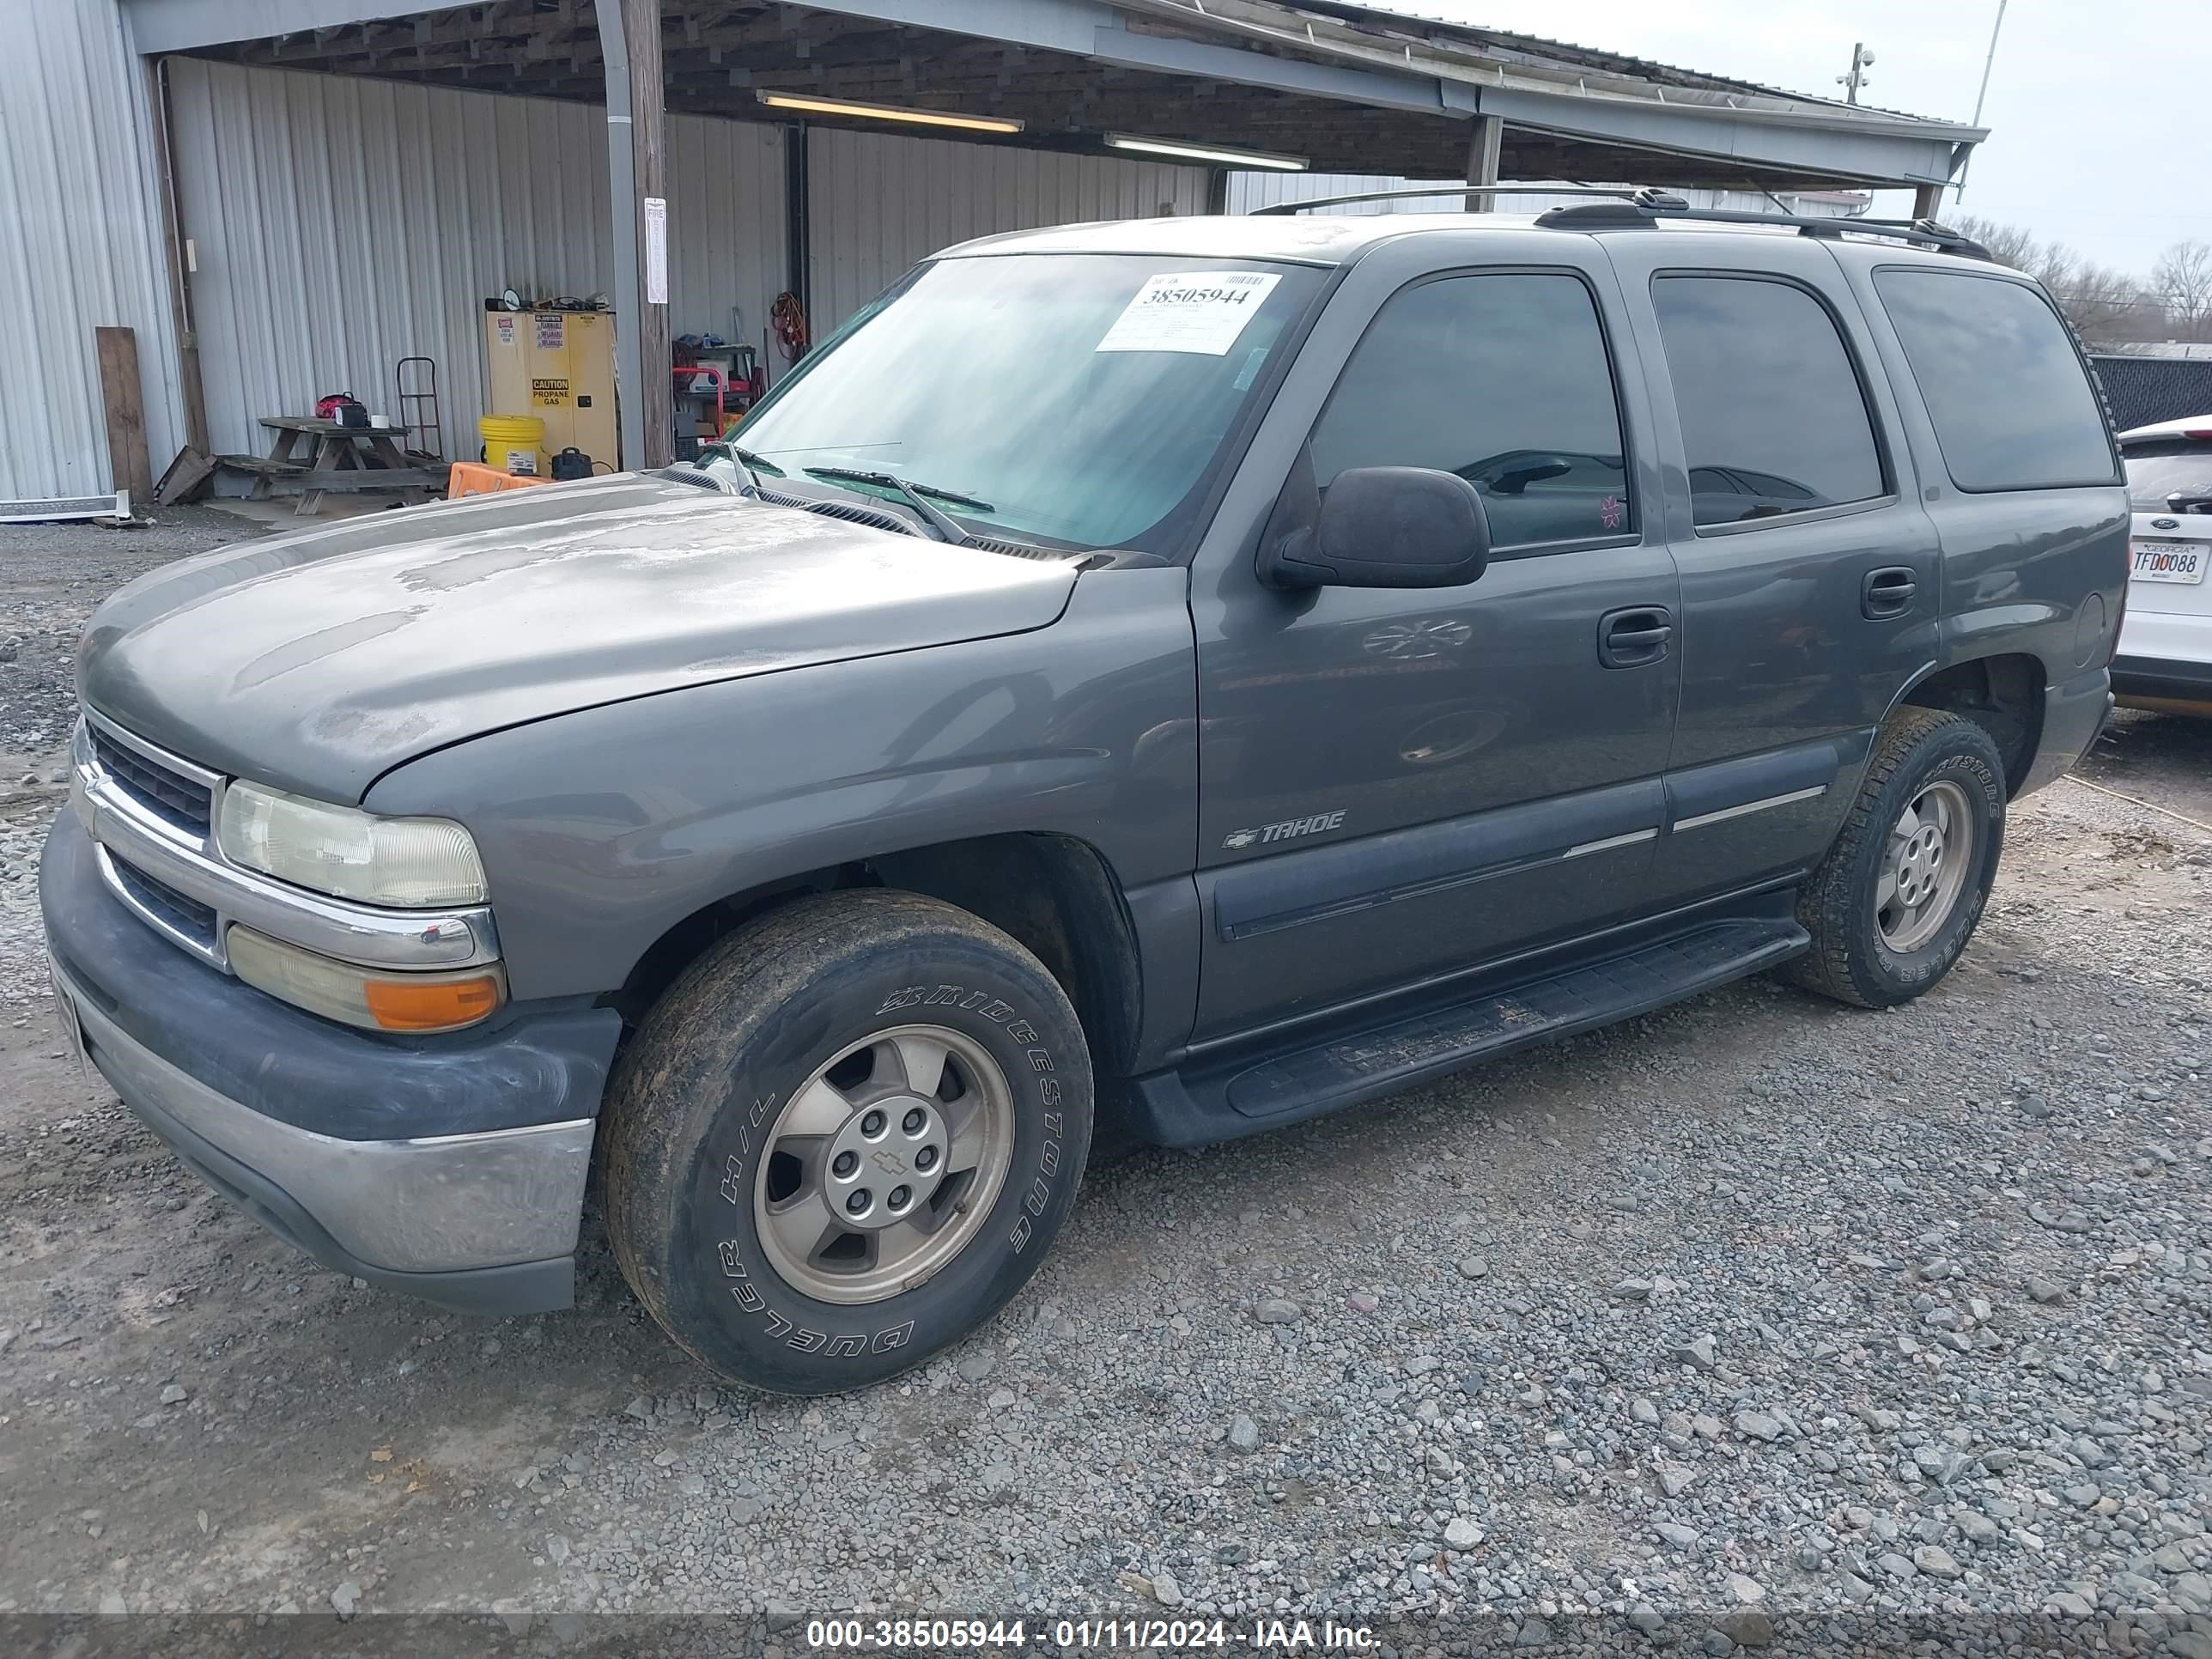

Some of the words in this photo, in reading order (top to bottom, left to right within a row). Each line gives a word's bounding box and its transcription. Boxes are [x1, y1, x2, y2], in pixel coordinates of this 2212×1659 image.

[648, 209, 664, 218] FIRE
[1143, 288, 1251, 305] 38505944
[533, 380, 568, 389] CAUTION
[2147, 544, 2190, 554] GEORGIA
[2134, 552, 2197, 573] TFD0088
[1261, 811, 1346, 843] TAHOE
[875, 984, 1063, 1255] BRIDGESTONE
[720, 1092, 776, 1205] H/L
[718, 1240, 916, 1358] DUELER
